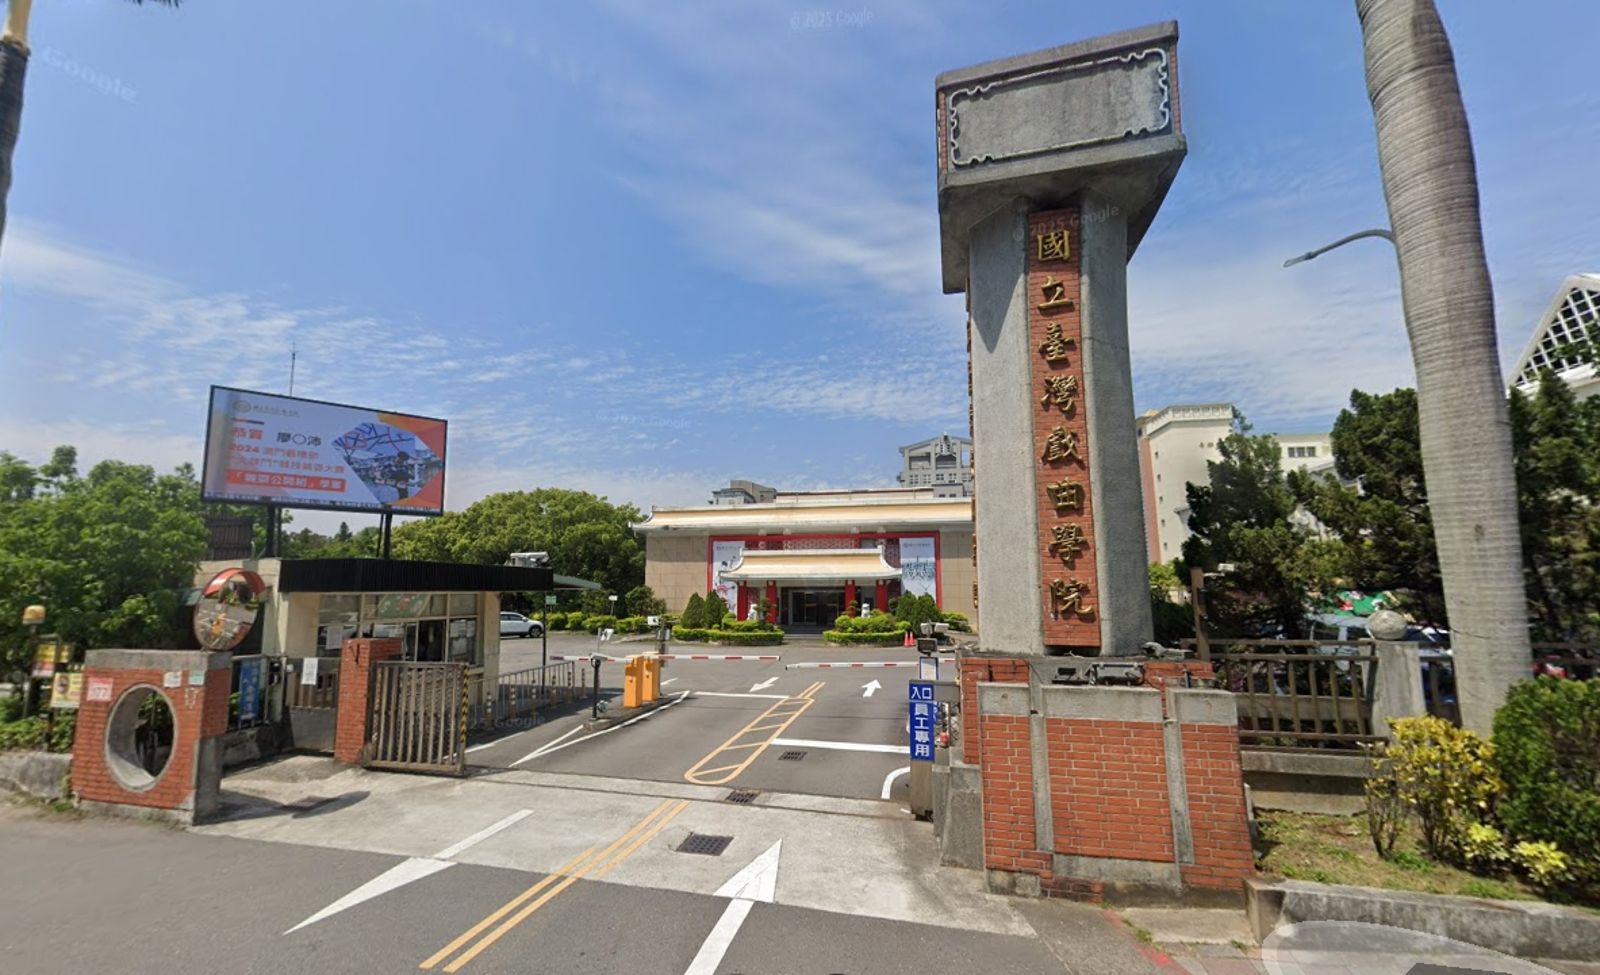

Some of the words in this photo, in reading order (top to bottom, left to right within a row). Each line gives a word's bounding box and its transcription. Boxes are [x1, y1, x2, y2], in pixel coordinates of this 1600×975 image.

[1036, 229, 1095, 617] 國立臺灣戲曲學院
[911, 686, 932, 700] 入口
[914, 703, 930, 757] 員工專用
